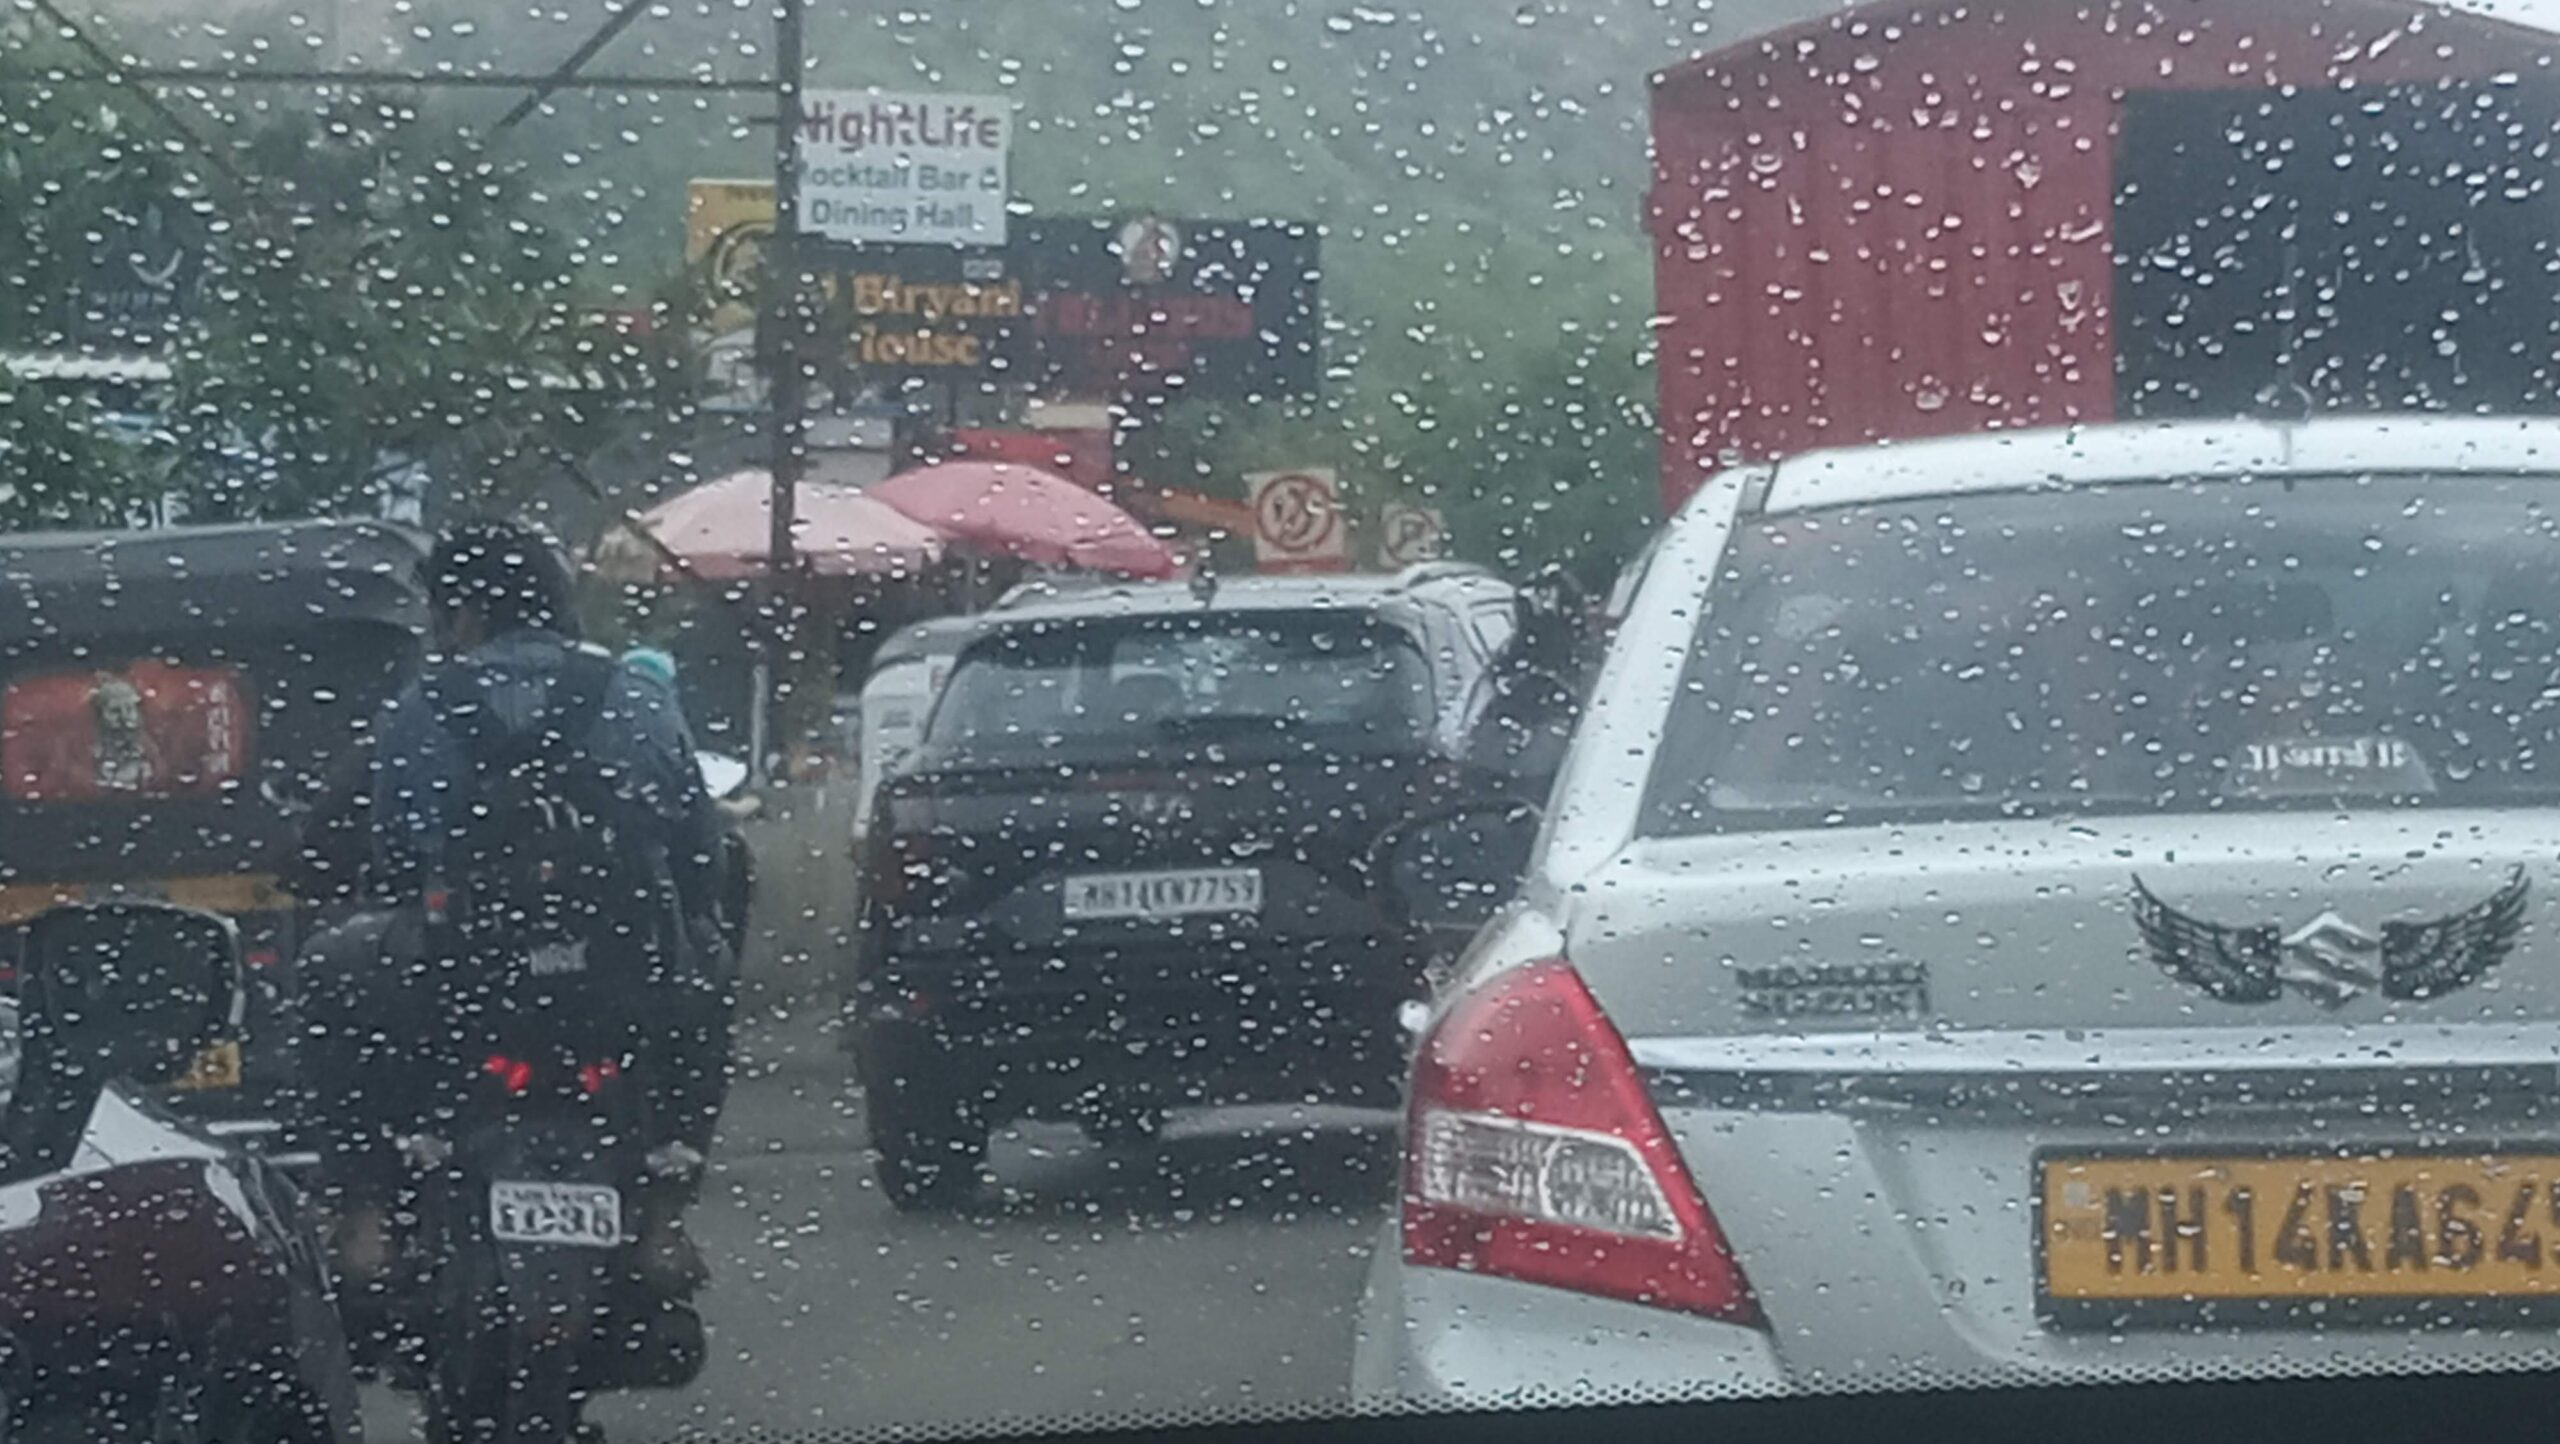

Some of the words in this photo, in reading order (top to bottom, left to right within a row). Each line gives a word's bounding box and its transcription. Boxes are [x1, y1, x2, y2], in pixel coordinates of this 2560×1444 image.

[800, 163, 909, 189] ocktail
[919, 164, 971, 191] Bar
[812, 199, 909, 234] Dining
[917, 203, 973, 227] Hall
[2103, 1183, 2560, 1275] MH14KA64
